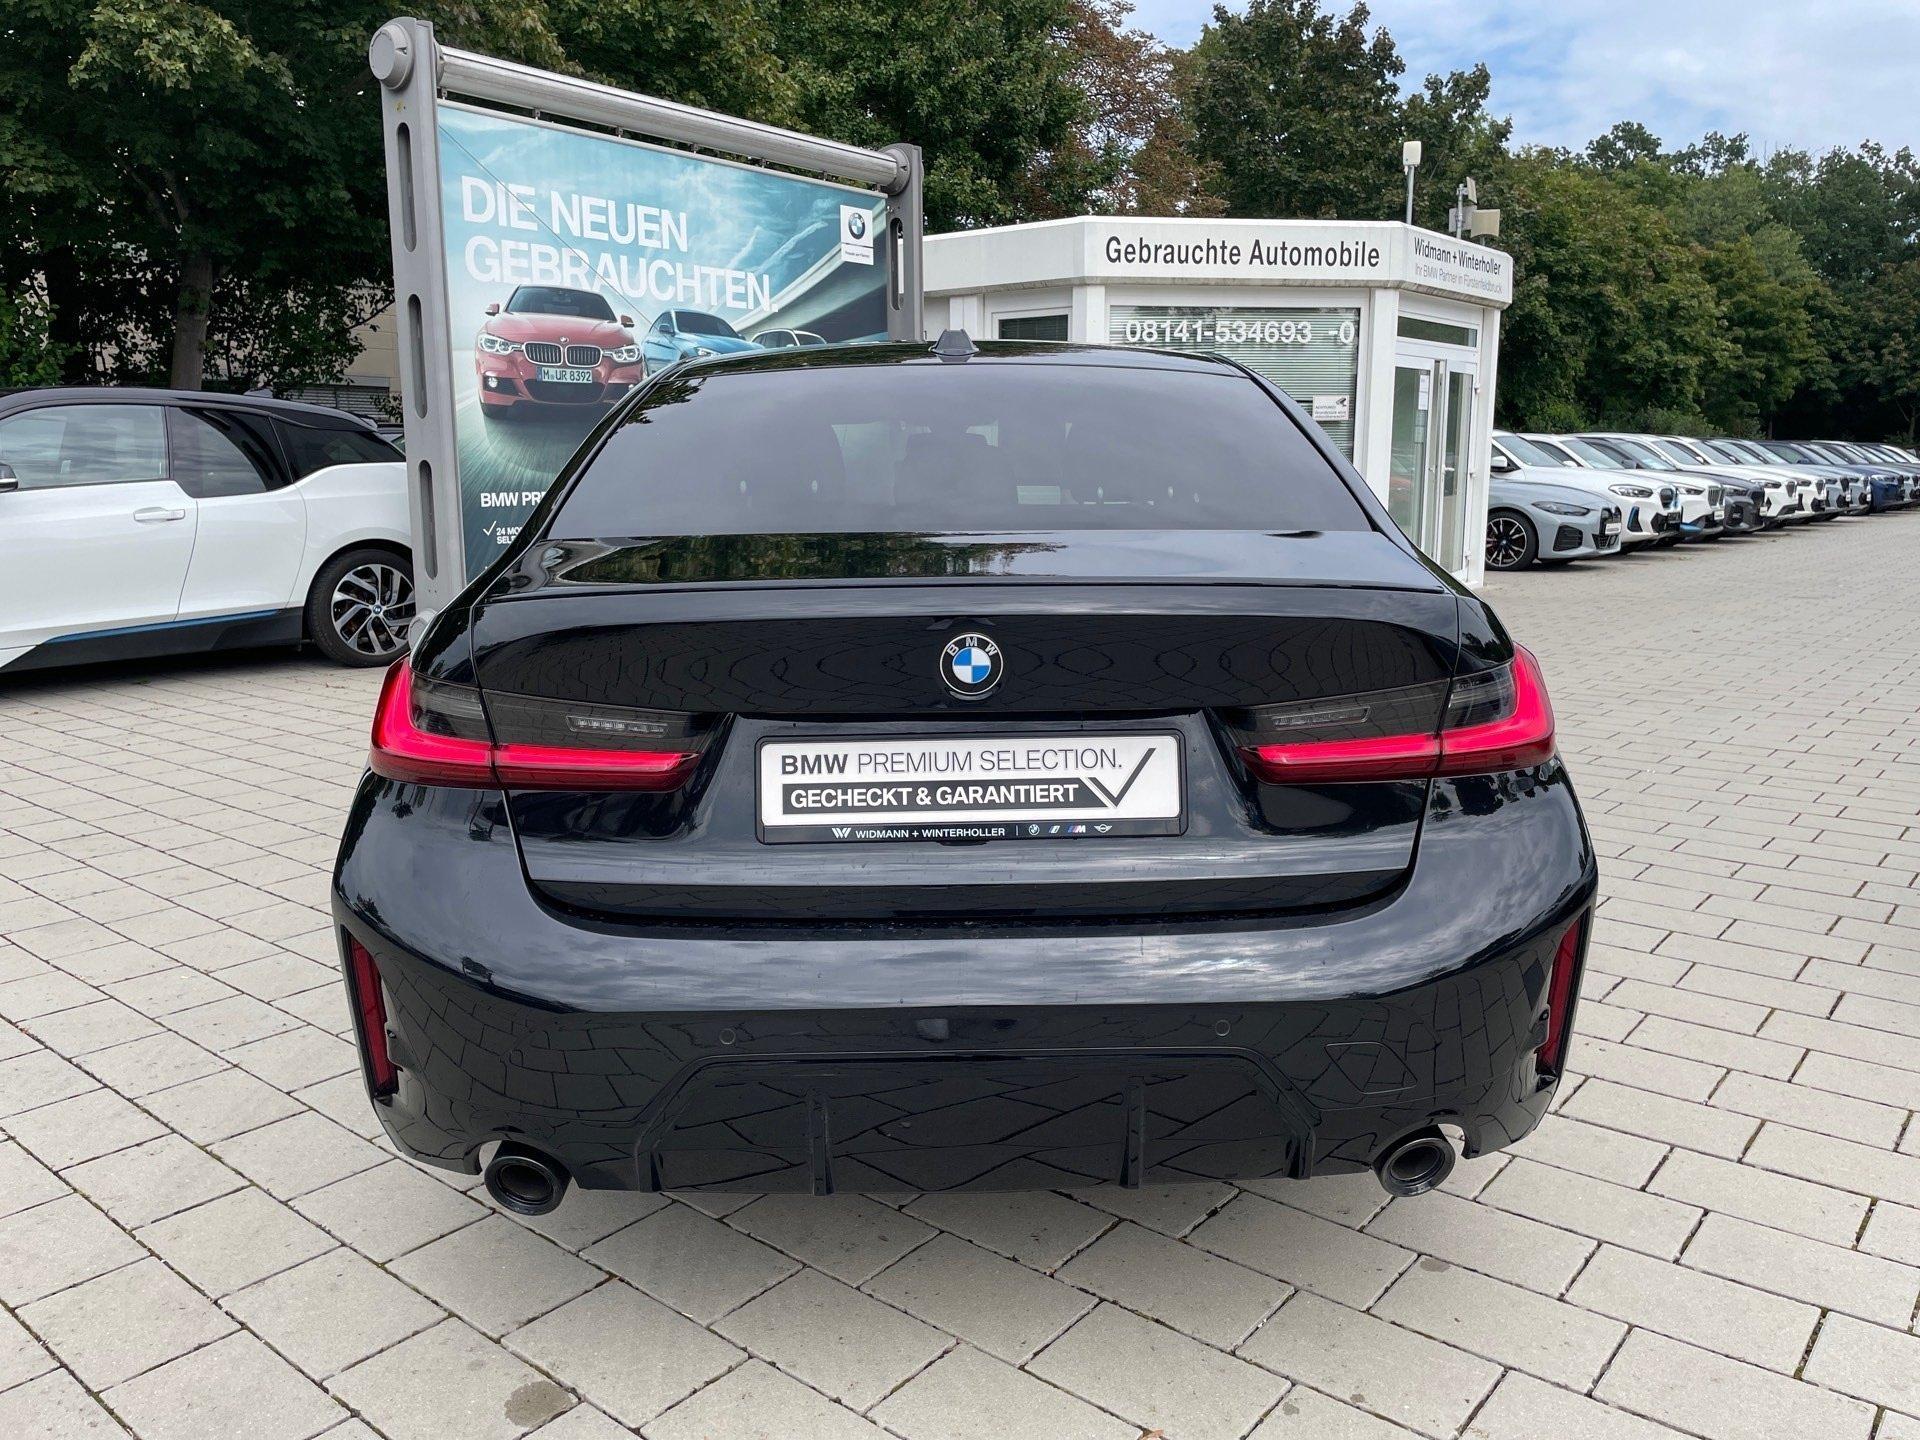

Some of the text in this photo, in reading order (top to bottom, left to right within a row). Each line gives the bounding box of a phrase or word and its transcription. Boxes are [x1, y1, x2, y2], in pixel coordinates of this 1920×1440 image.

[461, 175, 688, 252] DIE NEUEN
[1106, 236, 1380, 268] Gebrauchte Automobile
[1414, 237, 1451, 264] Widmann
[1458, 250, 1501, 275] Winterholler
[464, 235, 779, 313] GEBRAUCHTEN.
[1424, 264, 1438, 279] BMW
[1125, 319, 1312, 343] 08141-534693
[555, 370, 567, 381] UR
[569, 370, 591, 381] 8392
[480, 492, 519, 508] BMW
[496, 527, 506, 535] 24
[946, 636, 997, 656] BMW
[781, 748, 1123, 775] BMW PREMIUM SELECTION.
[790, 784, 1079, 808] GECHECKT & GARANTIERT
[855, 830, 909, 839] WIDMANN
[921, 828, 1006, 838] WINTERHOLLER
